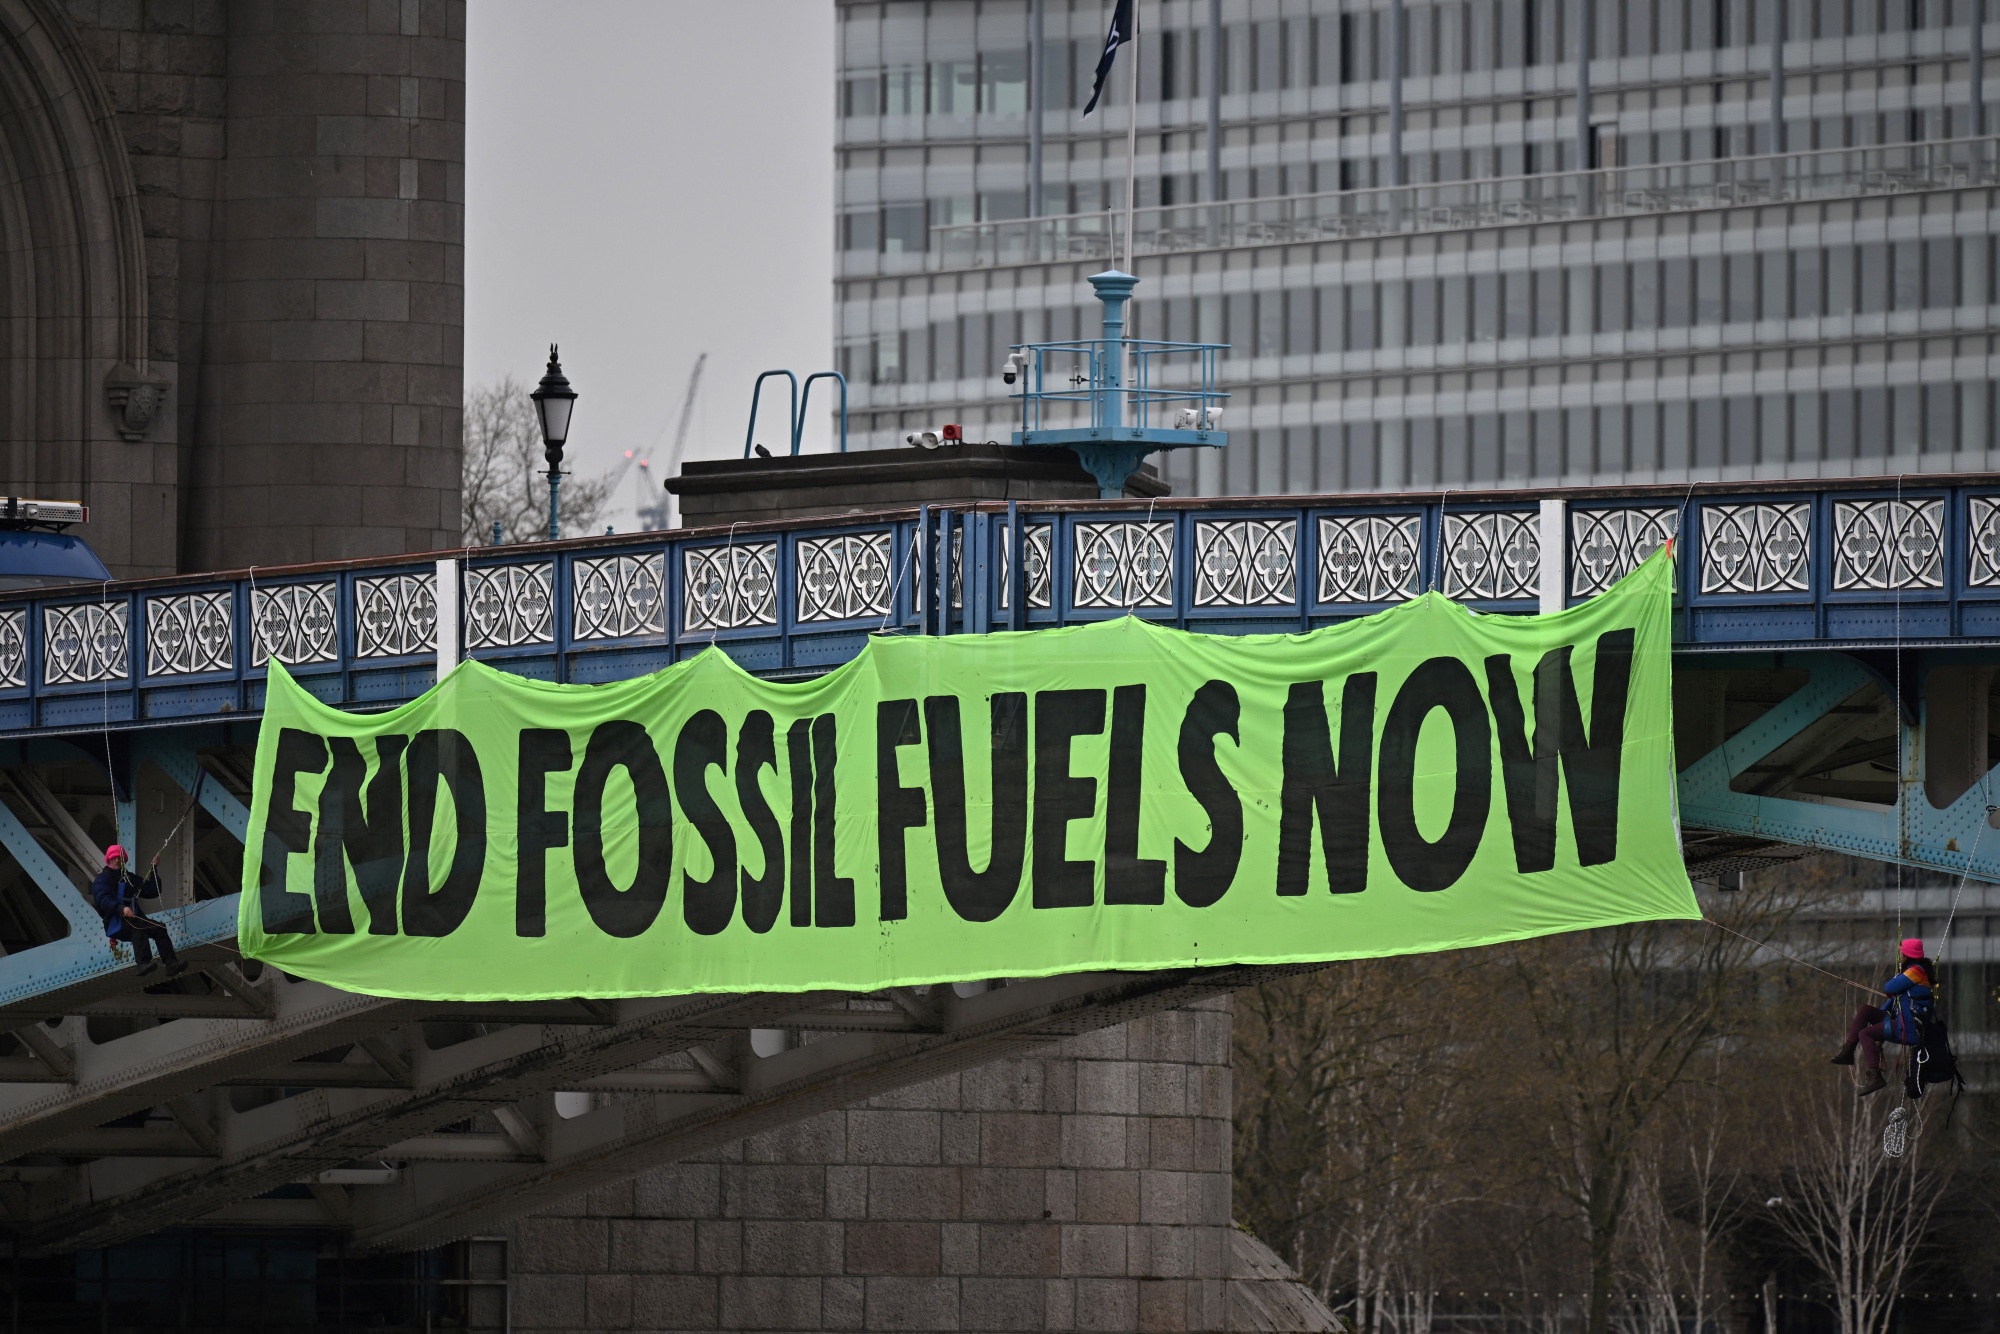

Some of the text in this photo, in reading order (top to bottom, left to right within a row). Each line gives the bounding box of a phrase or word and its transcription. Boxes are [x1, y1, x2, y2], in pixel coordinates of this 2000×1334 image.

[260, 627, 1637, 939] END FOSSIL FUELS NOW
